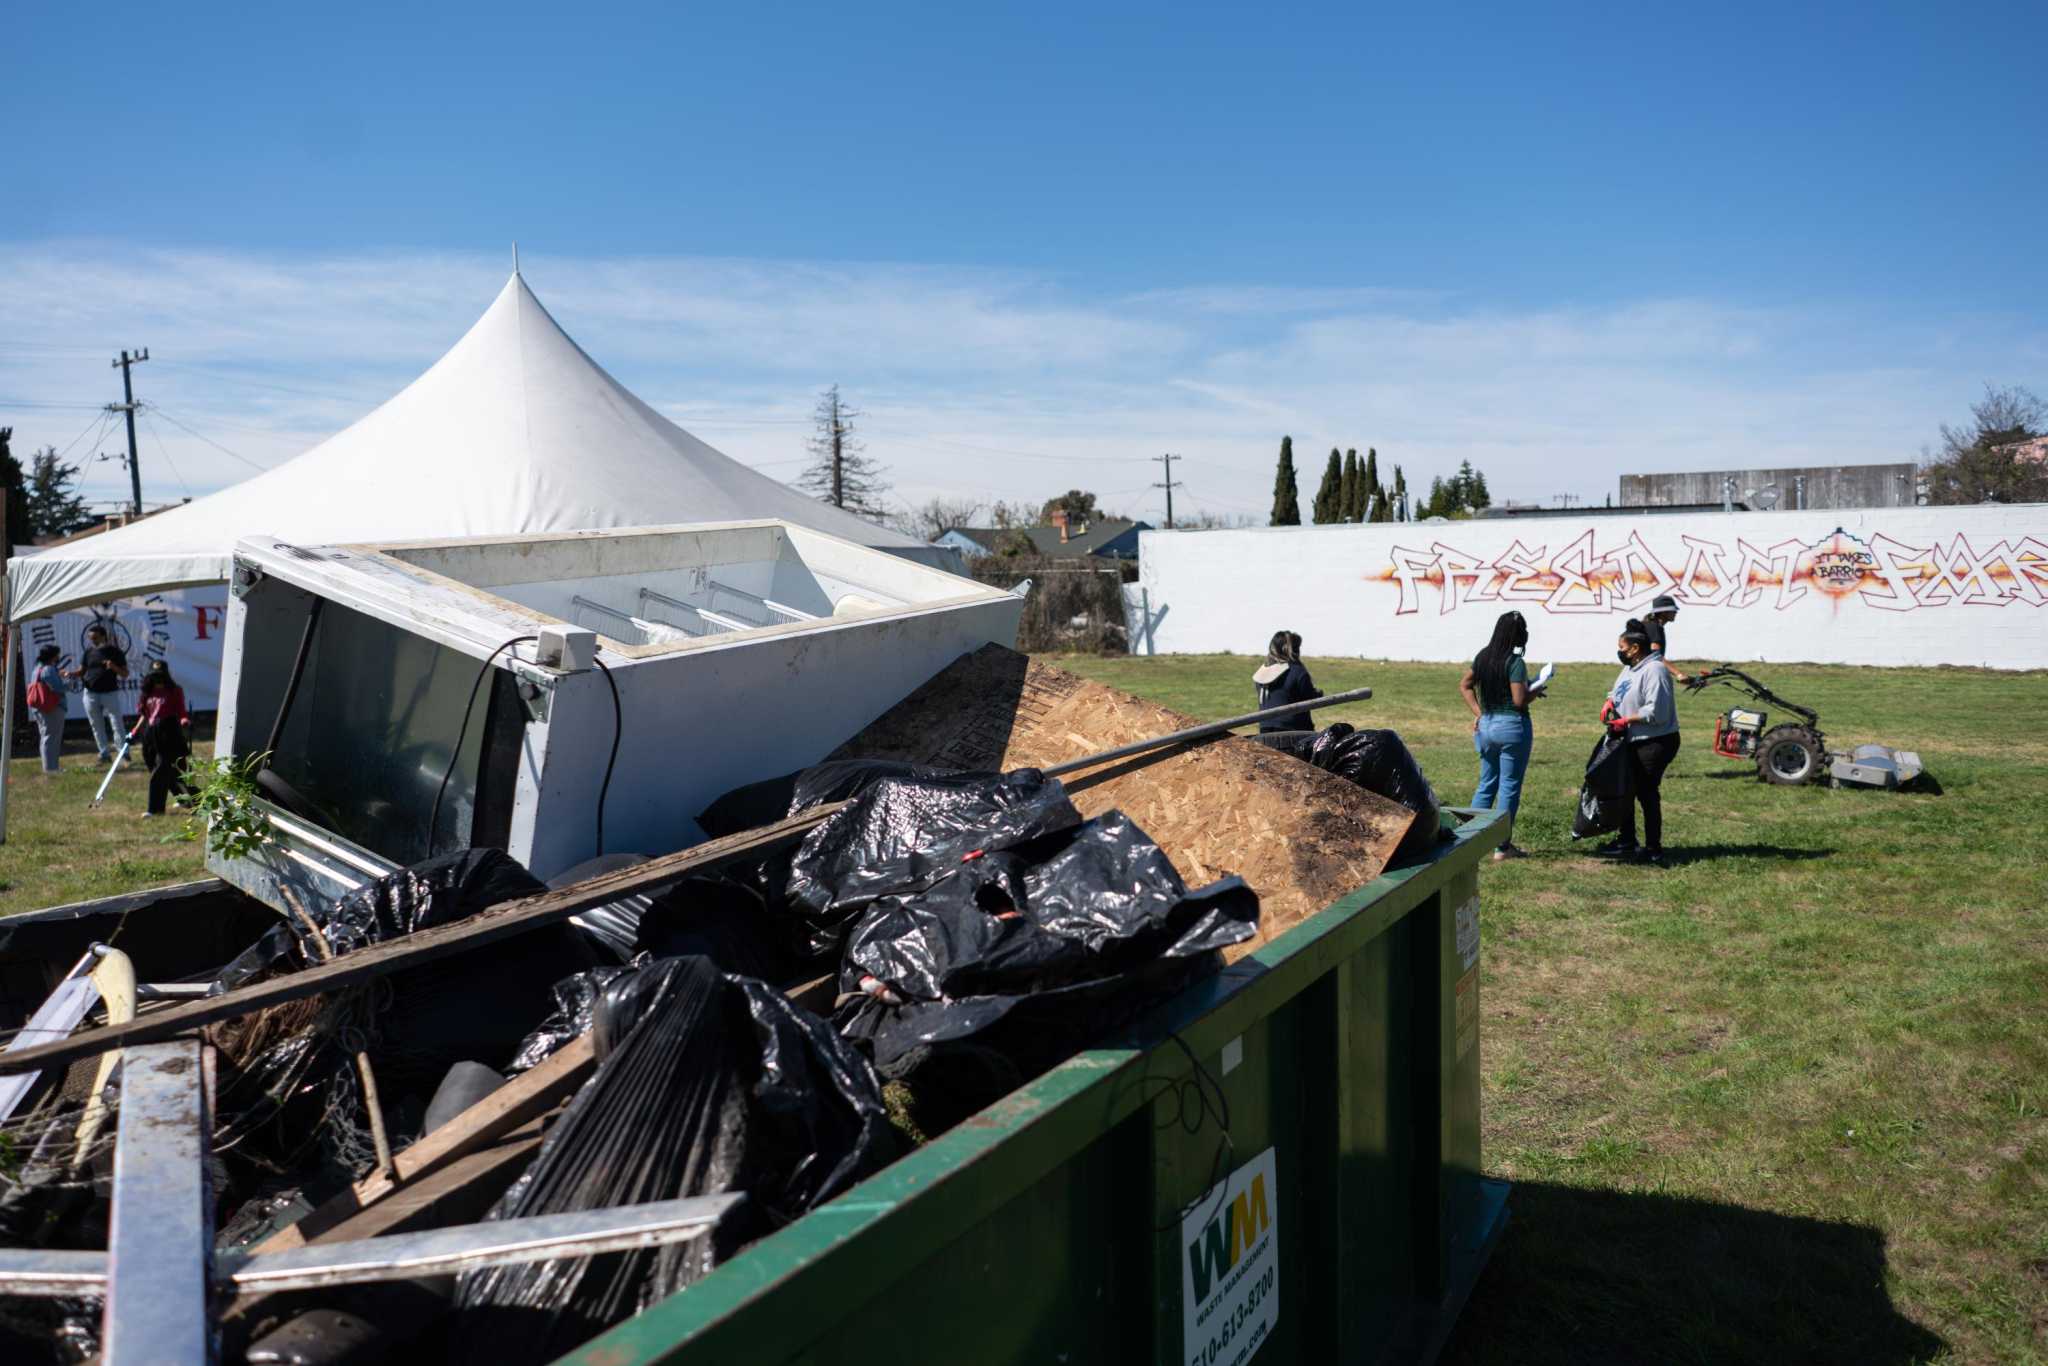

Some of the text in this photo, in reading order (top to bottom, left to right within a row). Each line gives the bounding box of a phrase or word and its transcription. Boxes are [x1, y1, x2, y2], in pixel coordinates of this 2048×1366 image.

[1815, 552, 1873, 565] IT TAKES
[1189, 1172, 1268, 1307] WM
[1196, 1235, 1270, 1327] WASTE MANAGEMENT
